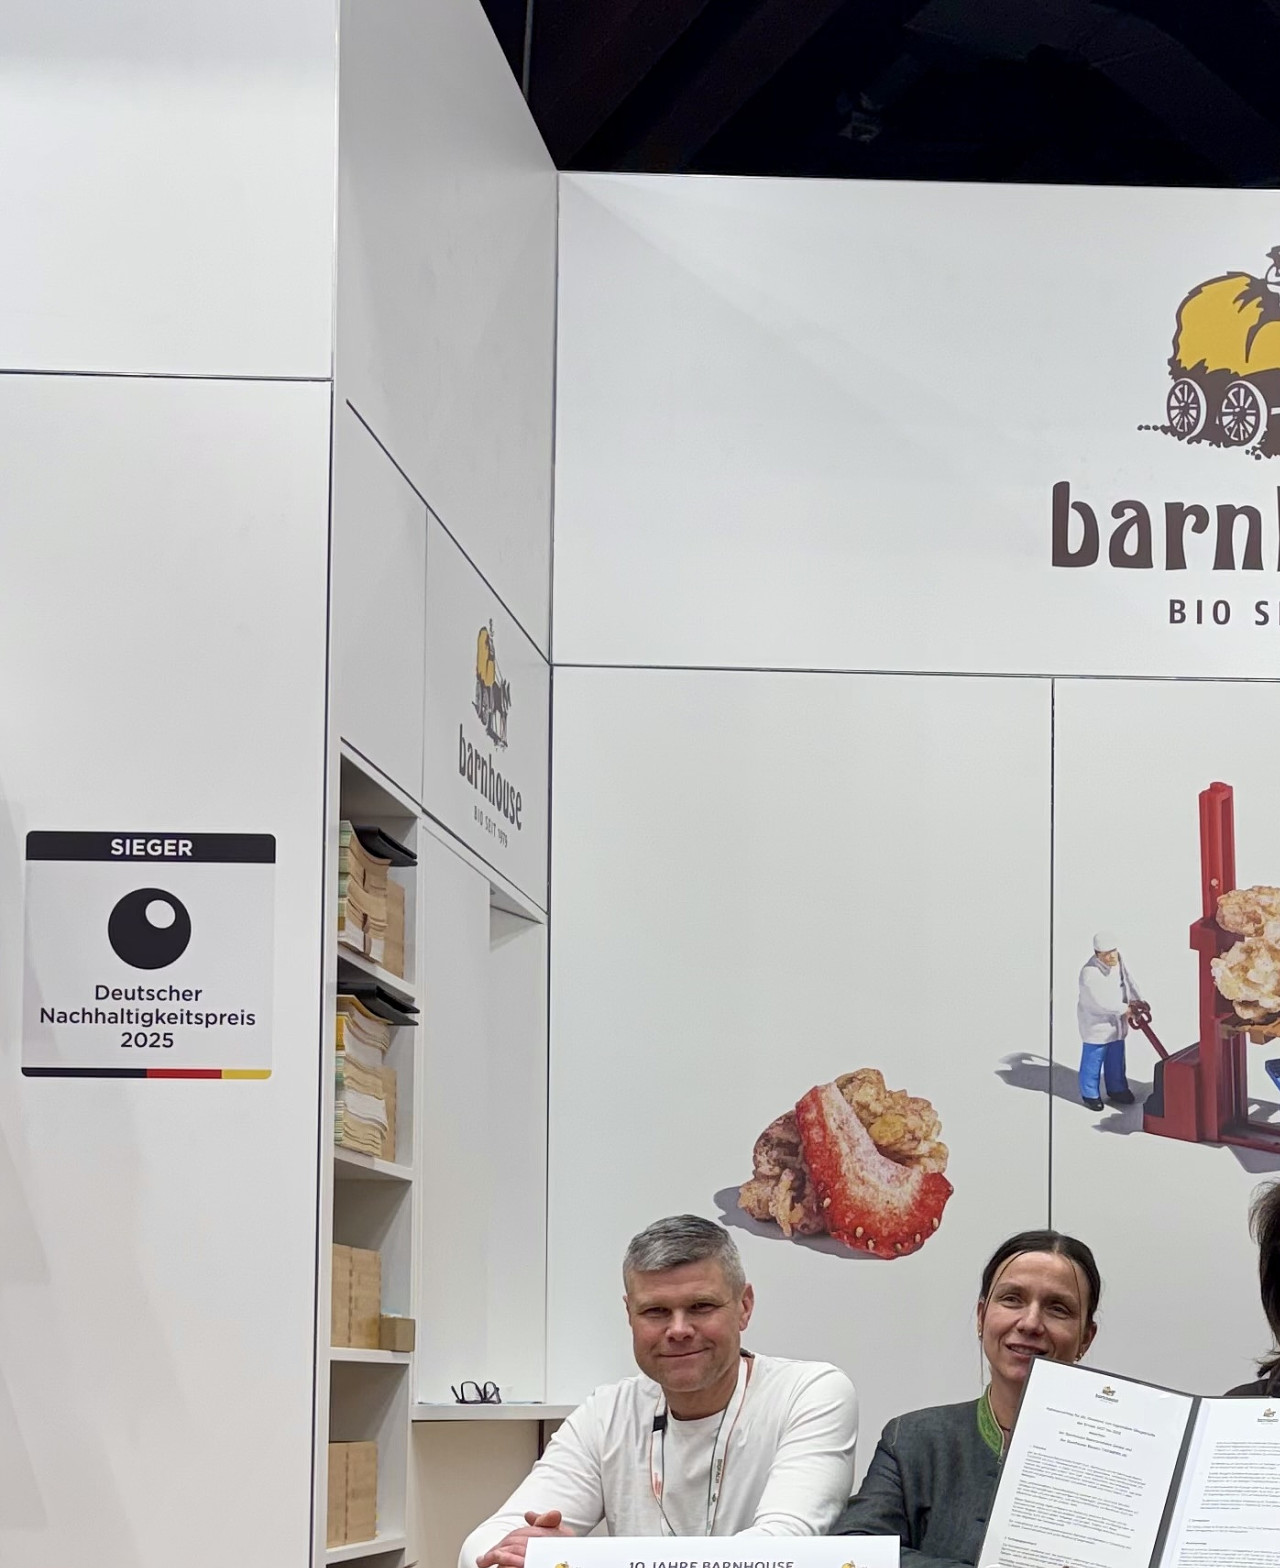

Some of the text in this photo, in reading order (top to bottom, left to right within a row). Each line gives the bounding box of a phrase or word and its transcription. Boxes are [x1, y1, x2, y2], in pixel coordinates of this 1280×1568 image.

[1169, 599, 1231, 625] BIO
[459, 723, 522, 831] barnhouse
[111, 839, 193, 856] SIEGER
[95, 984, 203, 1002] Deutscher
[40, 1008, 256, 1028] Nachhaltigkeitspreis
[121, 1032, 174, 1048] 2025
